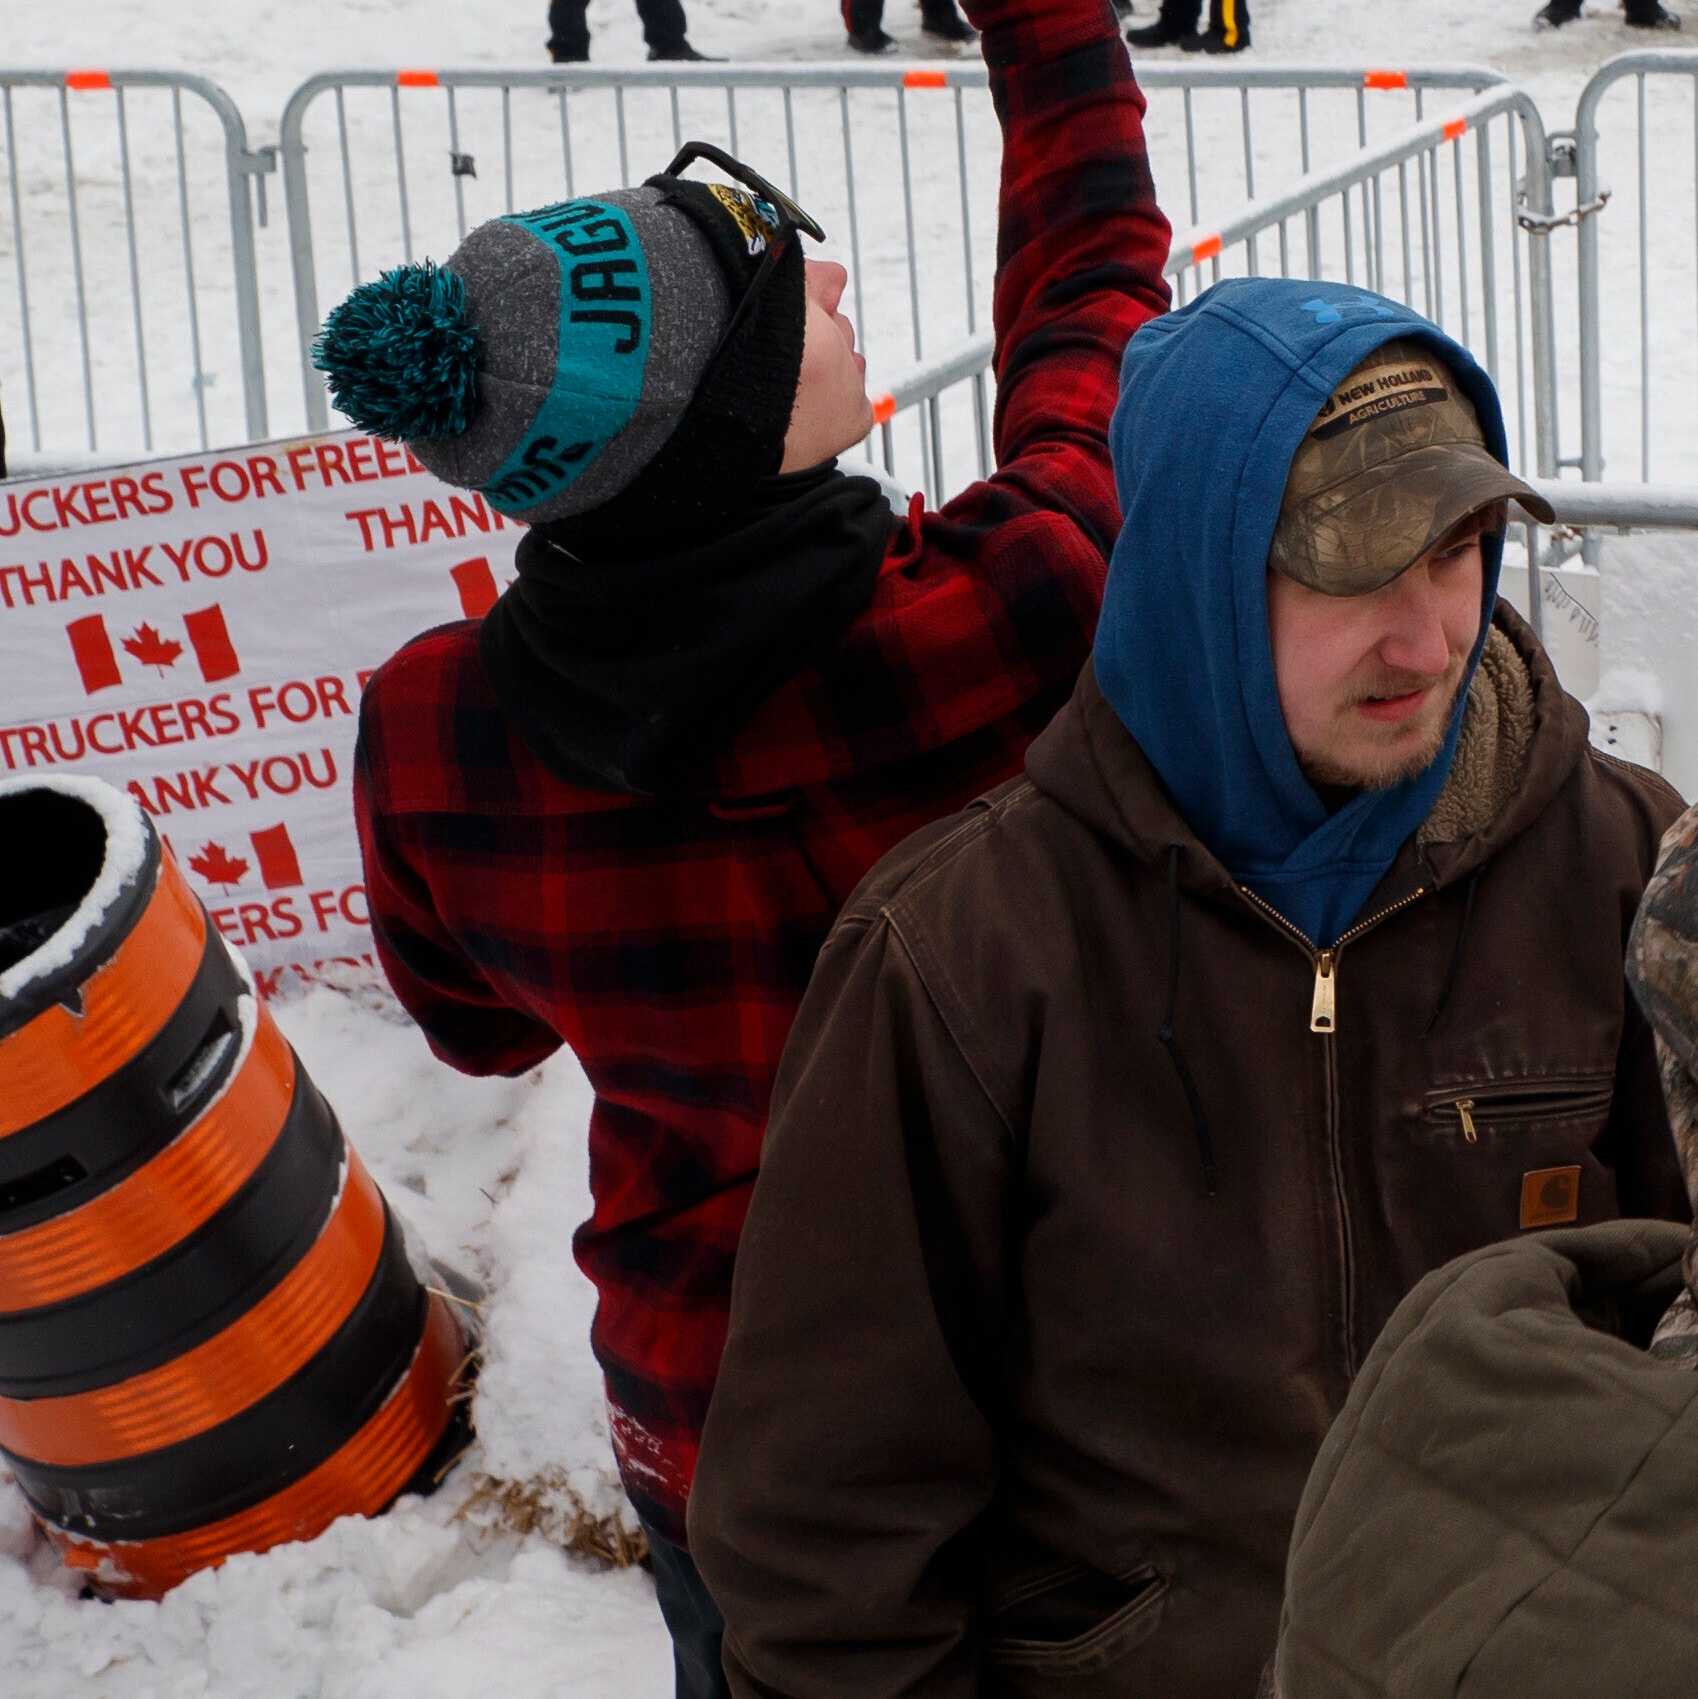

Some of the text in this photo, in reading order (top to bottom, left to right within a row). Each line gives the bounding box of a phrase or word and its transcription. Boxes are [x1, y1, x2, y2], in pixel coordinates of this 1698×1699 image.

[510, 201, 642, 354] JAGU
[1338, 369, 1433, 405] NEW HOLLAND
[1348, 390, 1427, 424] AGRICULTURE
[0, 472, 174, 537] UCKERS
[181, 455, 285, 507] FOR
[288, 435, 427, 491] FREE
[0, 528, 269, 608] THANK YOU
[0, 676, 353, 770] TRUCKERS FOR
[126, 748, 338, 816] ANK YOU
[308, 885, 371, 933] FO
